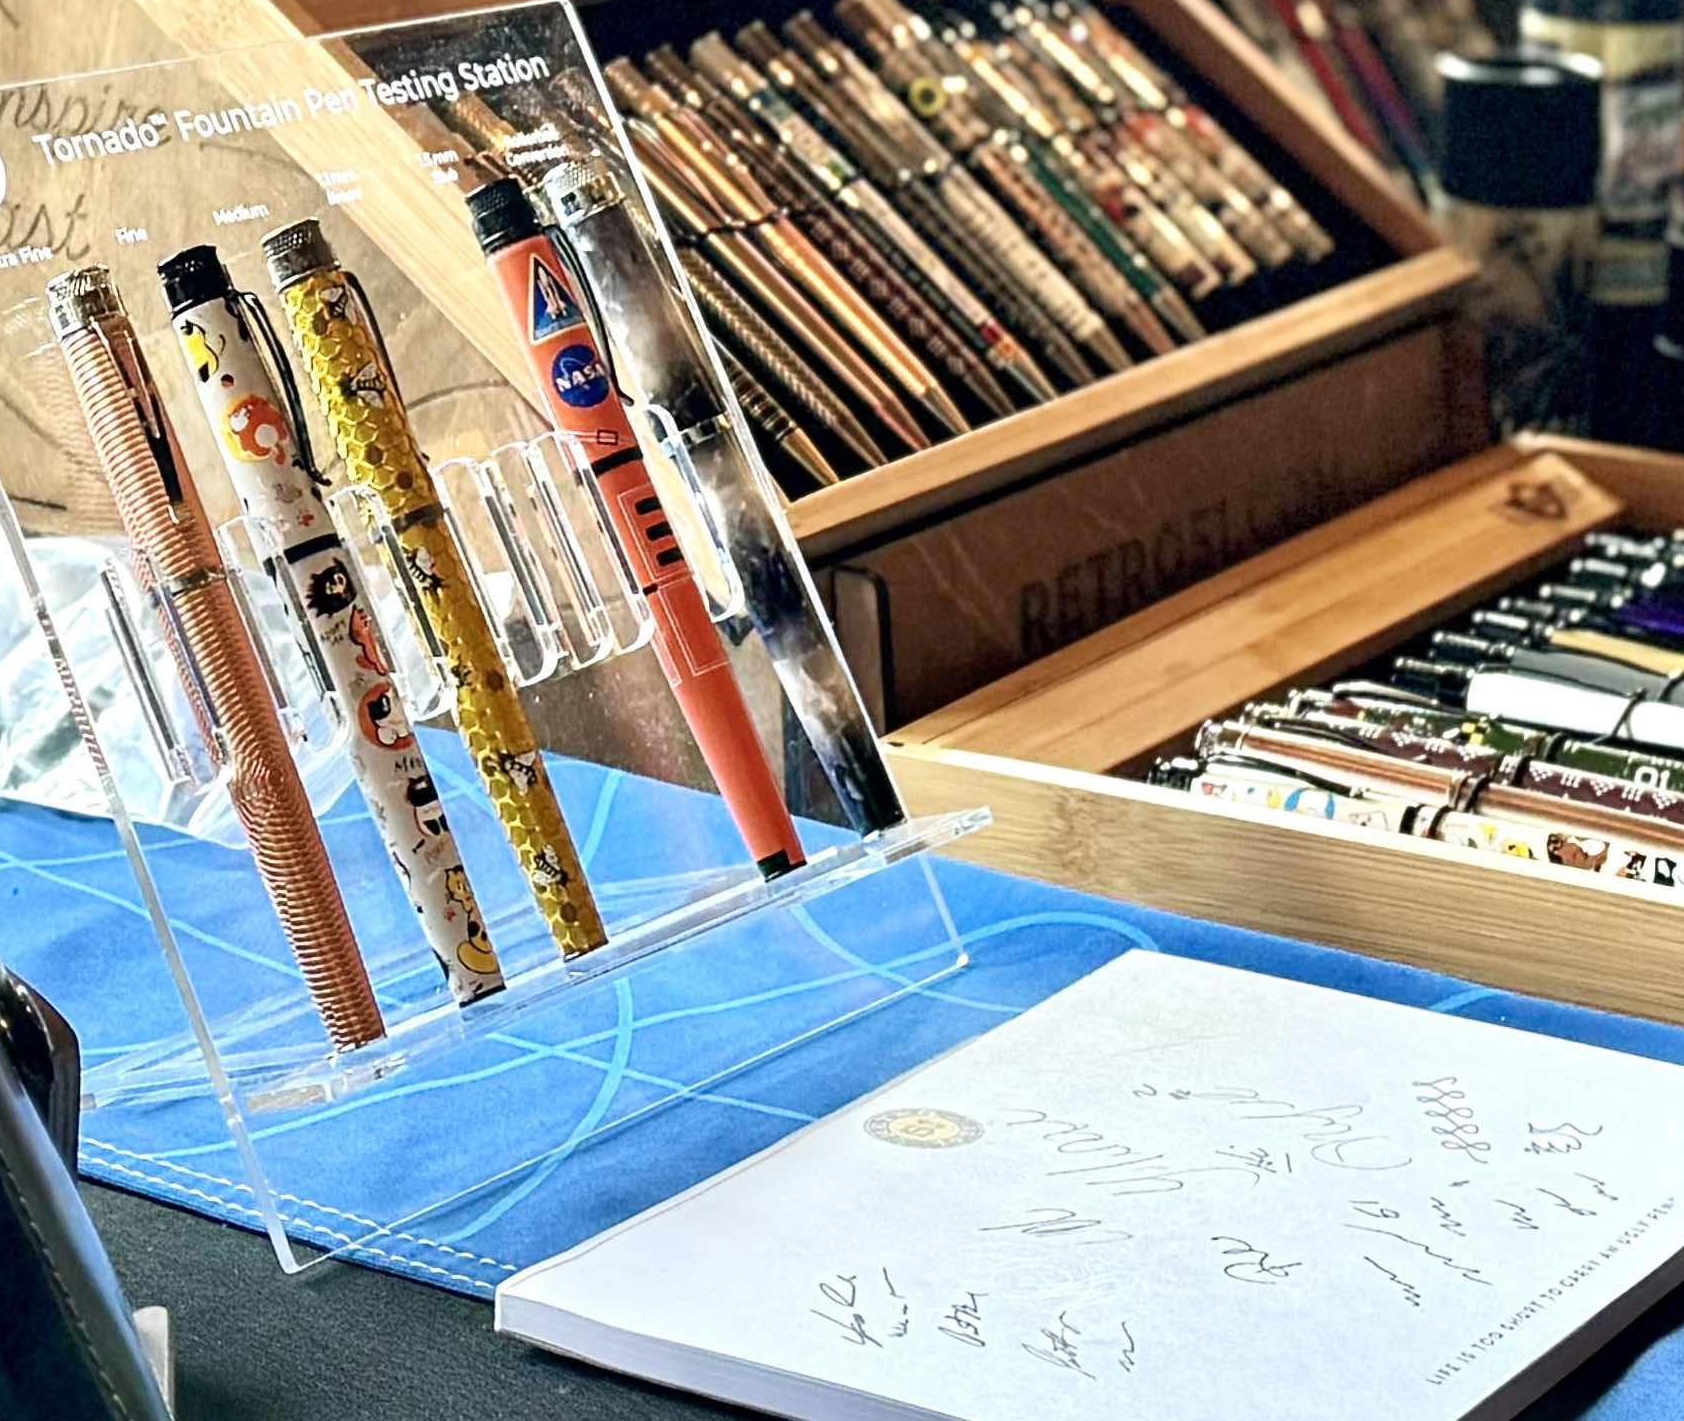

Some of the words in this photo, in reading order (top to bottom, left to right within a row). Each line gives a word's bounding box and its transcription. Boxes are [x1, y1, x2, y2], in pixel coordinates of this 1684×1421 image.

[173, 92, 303, 142] Fountain
[303, 83, 360, 119] Pen
[362, 64, 460, 108] Testing
[457, 52, 551, 92] Station
